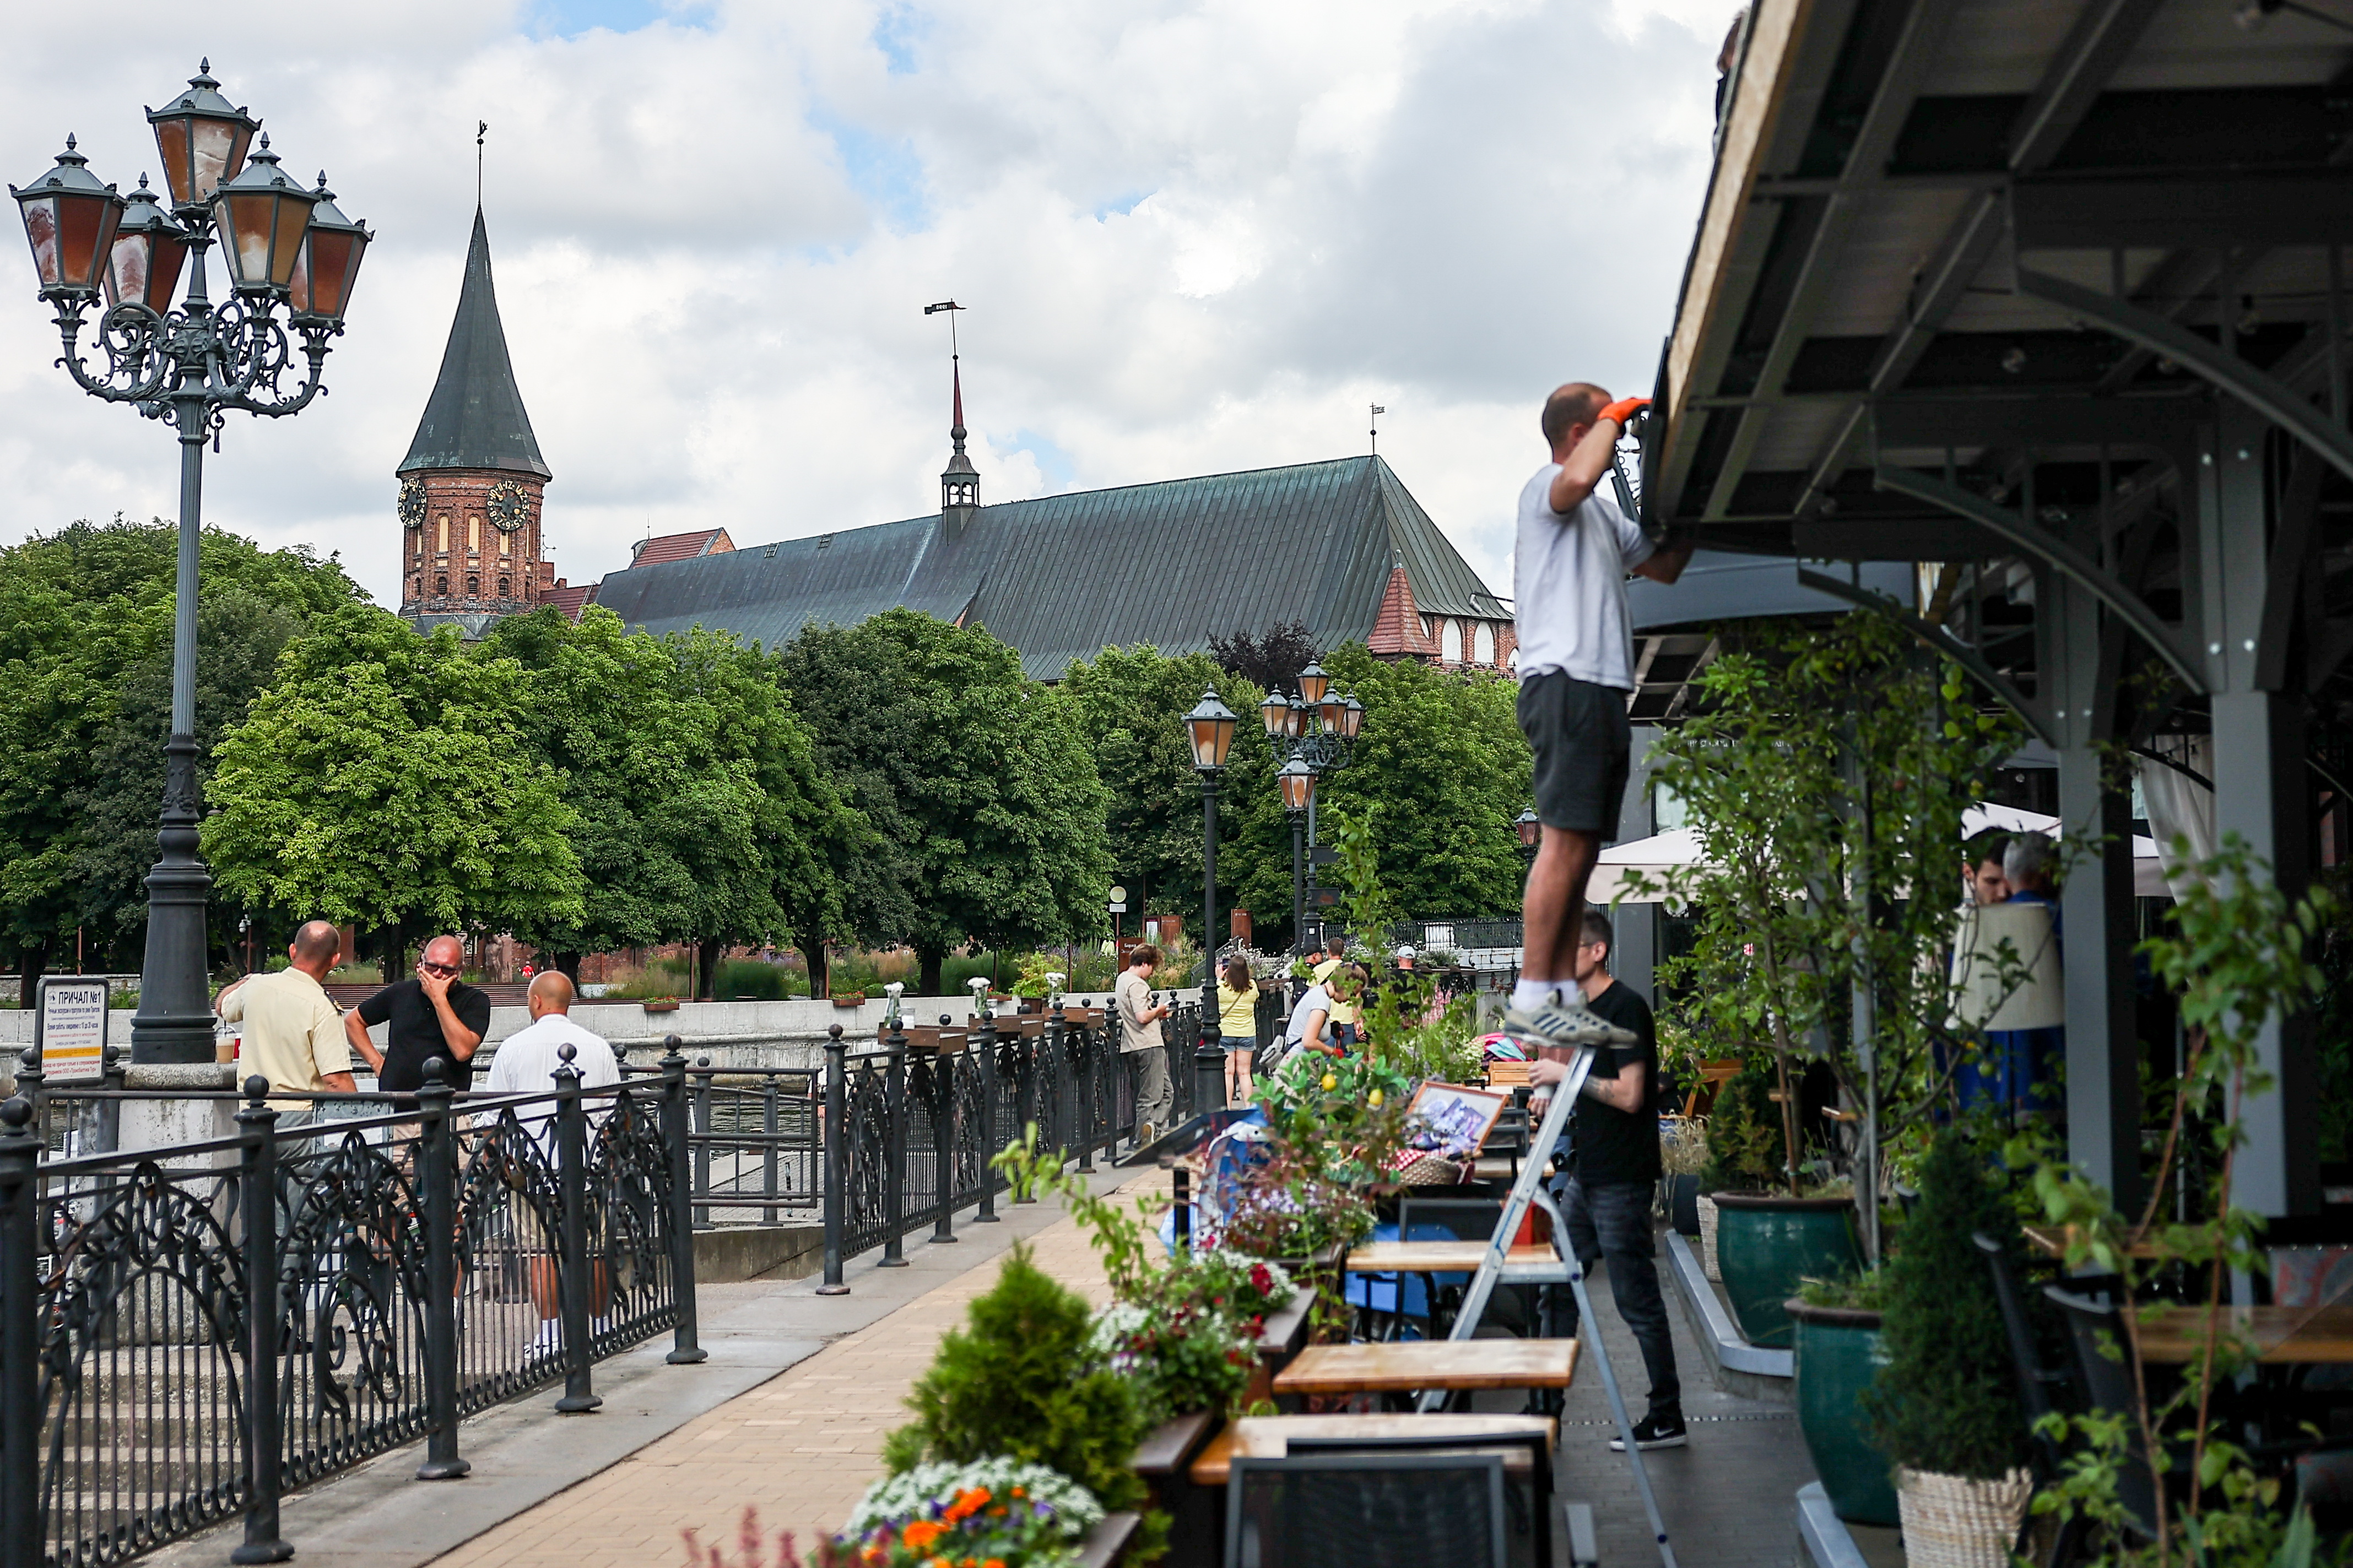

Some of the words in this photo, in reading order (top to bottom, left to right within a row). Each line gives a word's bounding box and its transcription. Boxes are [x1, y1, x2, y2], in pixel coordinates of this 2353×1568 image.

[404, 482, 408, 490] 11
[409, 478, 414, 487] 12
[497, 482, 503, 491] 11
[505, 480, 513, 489] 12
[419, 486, 425, 495] 2
[489, 489, 497, 499] 10
[520, 492, 528, 501] 2
[410, 519, 414, 527] 6
[416, 515, 421, 524] 5
[514, 519, 520, 528] 5
[506, 521, 510, 530] 6
[59, 991, 88, 1004] ПРИЧАЛ
[90, 991, 100, 1003] №1
